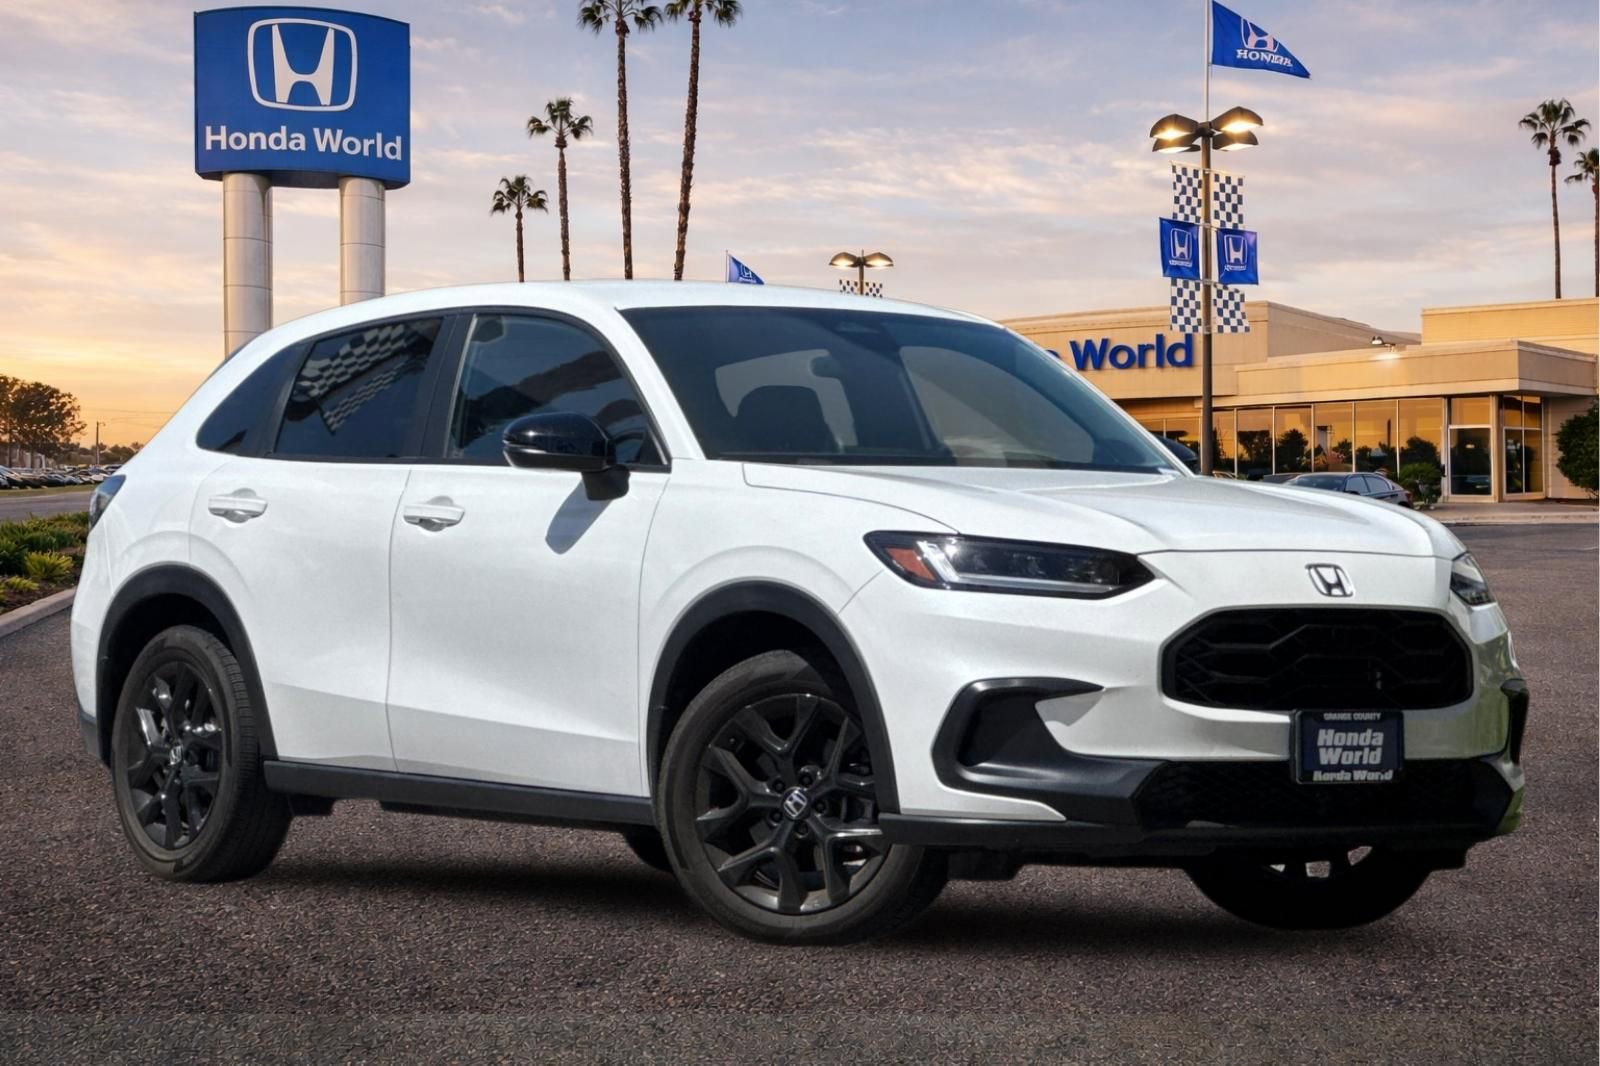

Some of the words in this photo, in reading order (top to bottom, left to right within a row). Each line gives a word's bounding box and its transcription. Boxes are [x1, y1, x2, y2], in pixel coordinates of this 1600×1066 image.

[205, 125, 306, 151] Honda
[313, 127, 402, 160] World
[1069, 333, 1194, 370] World
[1317, 729, 1384, 746] Honda
[1319, 747, 1382, 765] World
